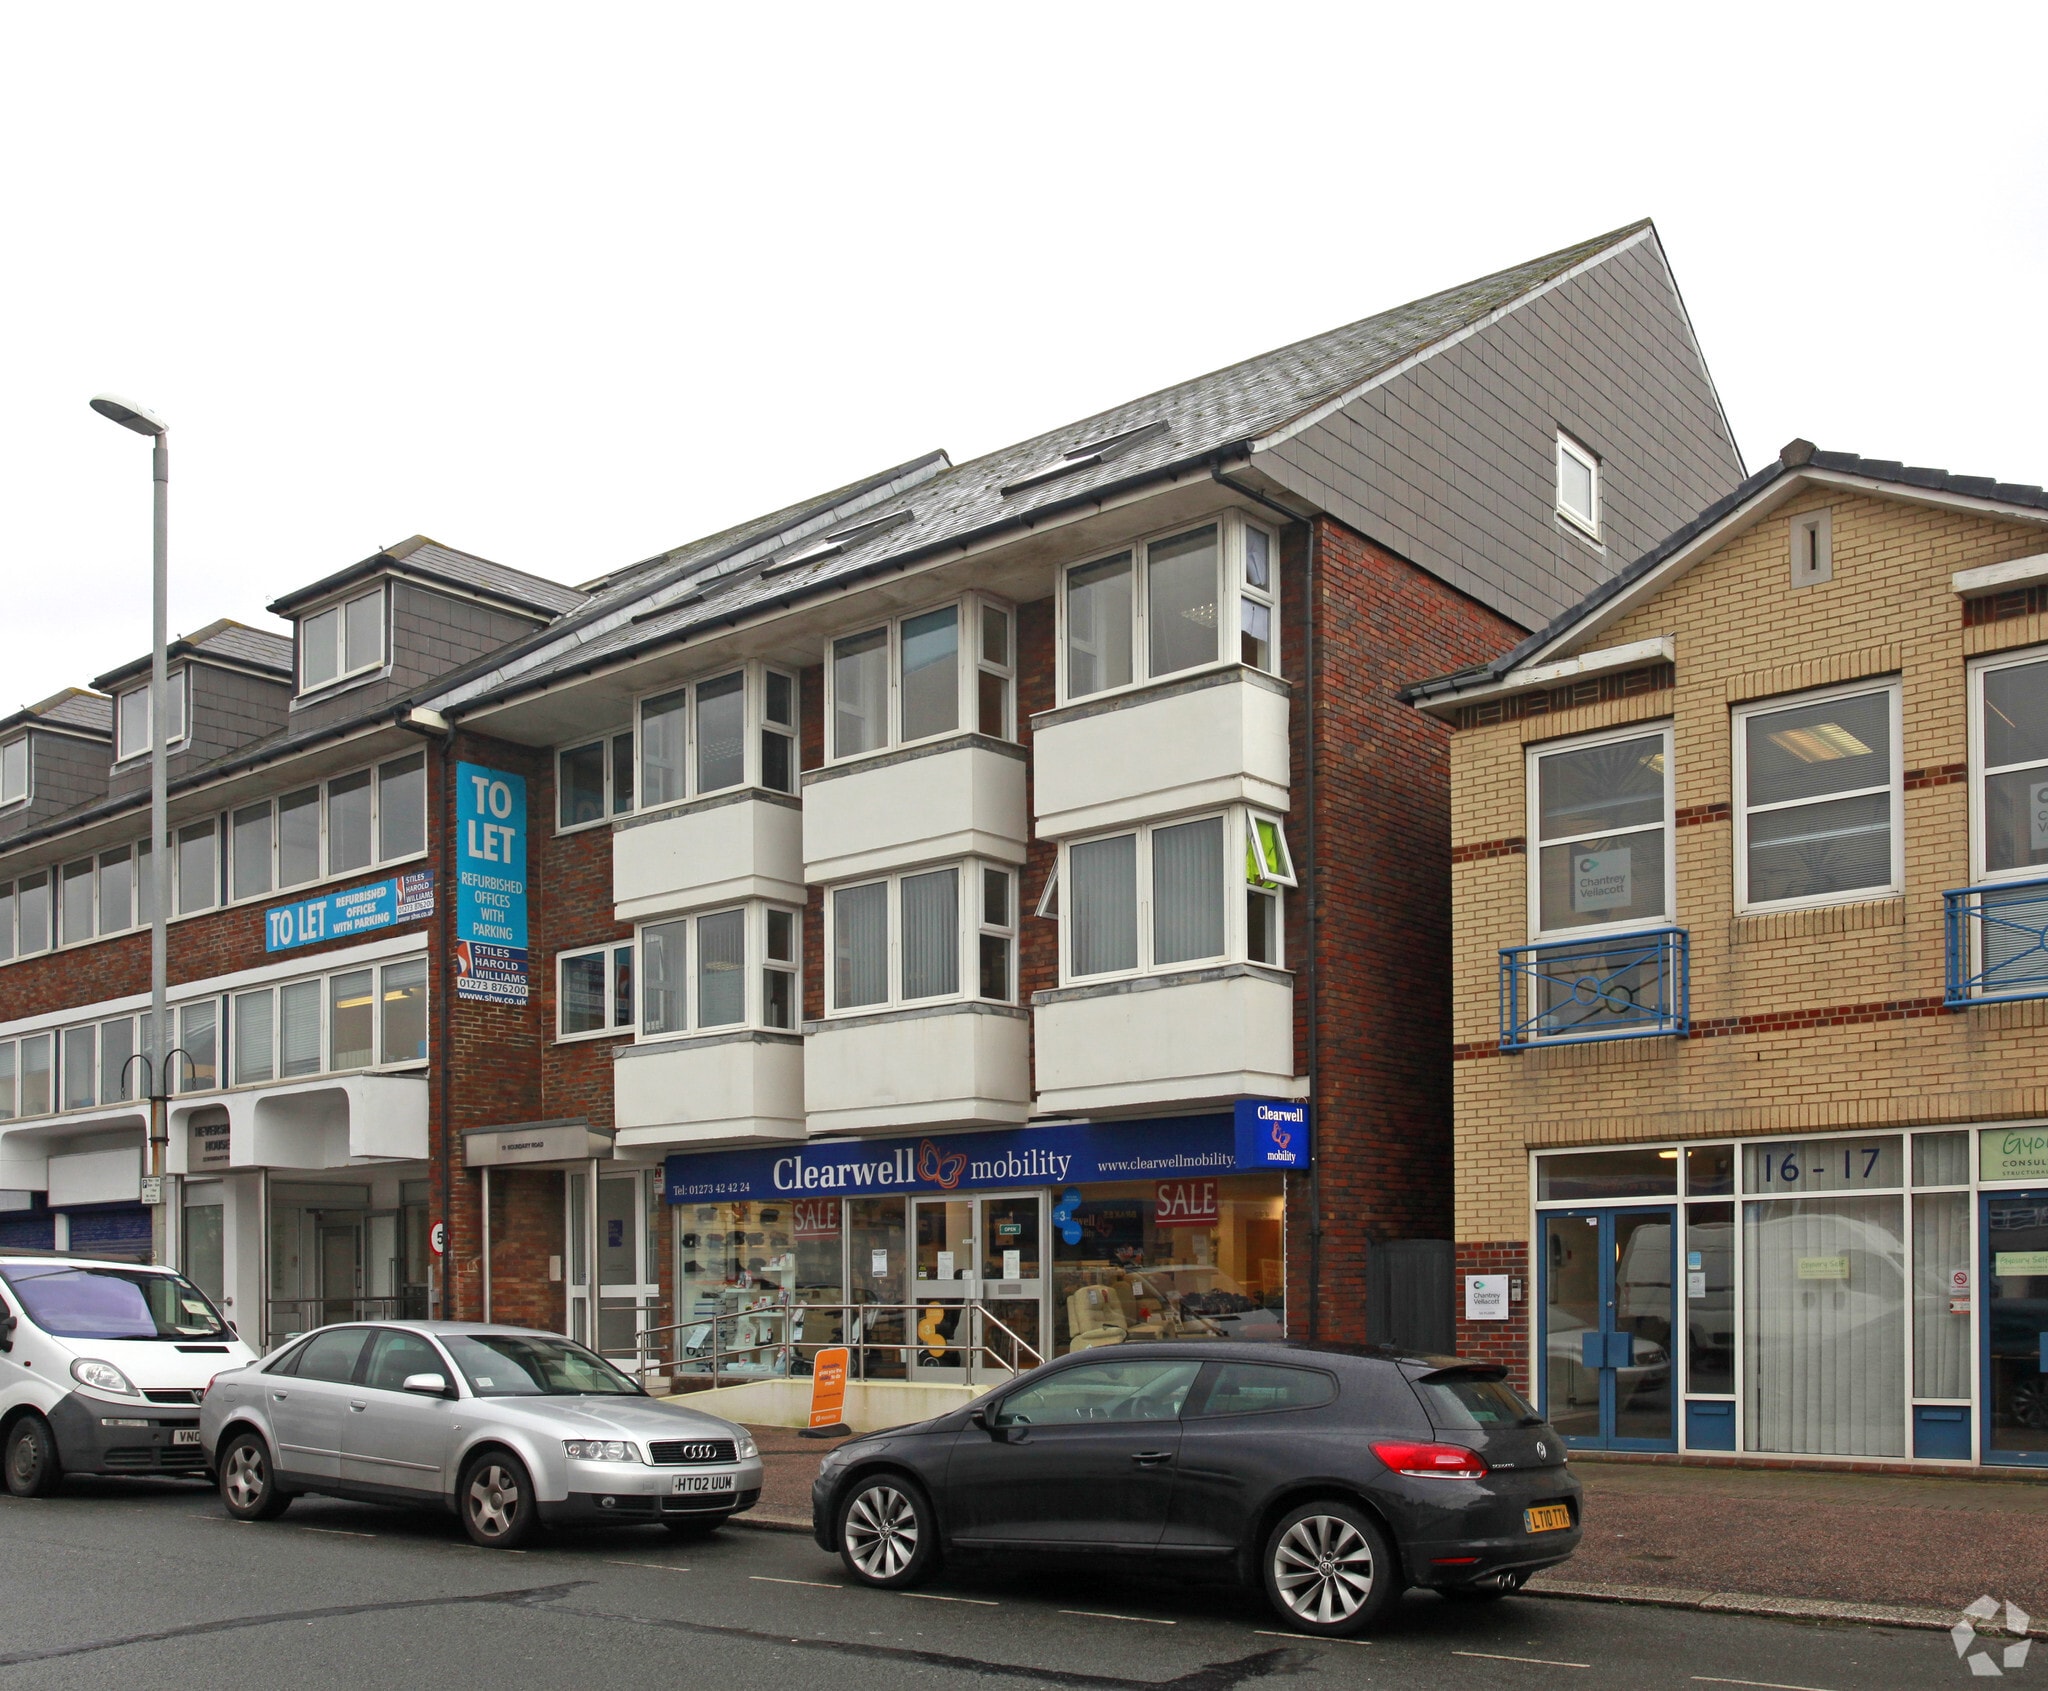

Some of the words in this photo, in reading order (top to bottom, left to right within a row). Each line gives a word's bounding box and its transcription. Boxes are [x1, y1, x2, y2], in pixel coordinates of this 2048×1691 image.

[471, 775, 512, 819] TO
[468, 819, 515, 864] LET
[405, 873, 425, 884] STILES
[461, 872, 523, 894] REFURBISHED
[1580, 874, 1626, 888] Chantrey
[405, 882, 430, 893] HAROLD
[1580, 884, 1625, 898] Vellacott
[335, 886, 387, 909] REFURBISHED
[406, 890, 434, 903] WILLIAMS
[474, 890, 510, 908] OFFICES
[346, 902, 377, 919] OFFICES
[481, 907, 504, 923] WITH
[270, 910, 293, 947] TO
[299, 901, 327, 942] LET
[333, 921, 353, 934] WITH
[354, 912, 390, 930] PARKING
[473, 922, 513, 940] PARKING
[474, 945, 510, 958] STILES
[474, 957, 518, 971] HAROLD
[475, 969, 526, 984] WILLIAMS
[459, 978, 488, 990] 01273
[491, 982, 526, 995] 876200
[458, 991, 527, 1006] www.shw.co.uk
[1257, 1105, 1304, 1123] Clearwell
[2002, 1132, 2048, 1155] Gyo
[1267, 1149, 1297, 1164] mobility
[773, 1148, 916, 1191] Clearwell
[970, 1149, 1072, 1181] mobility
[673, 1185, 688, 1196] Tel:
[689, 1184, 714, 1195] 01273
[715, 1183, 726, 1193] 42
[728, 1182, 738, 1193] 42
[740, 1181, 750, 1192] 24
[1157, 1183, 1217, 1216] SALE
[794, 1202, 837, 1231] SALE
[678, 1477, 709, 1491] HT02
